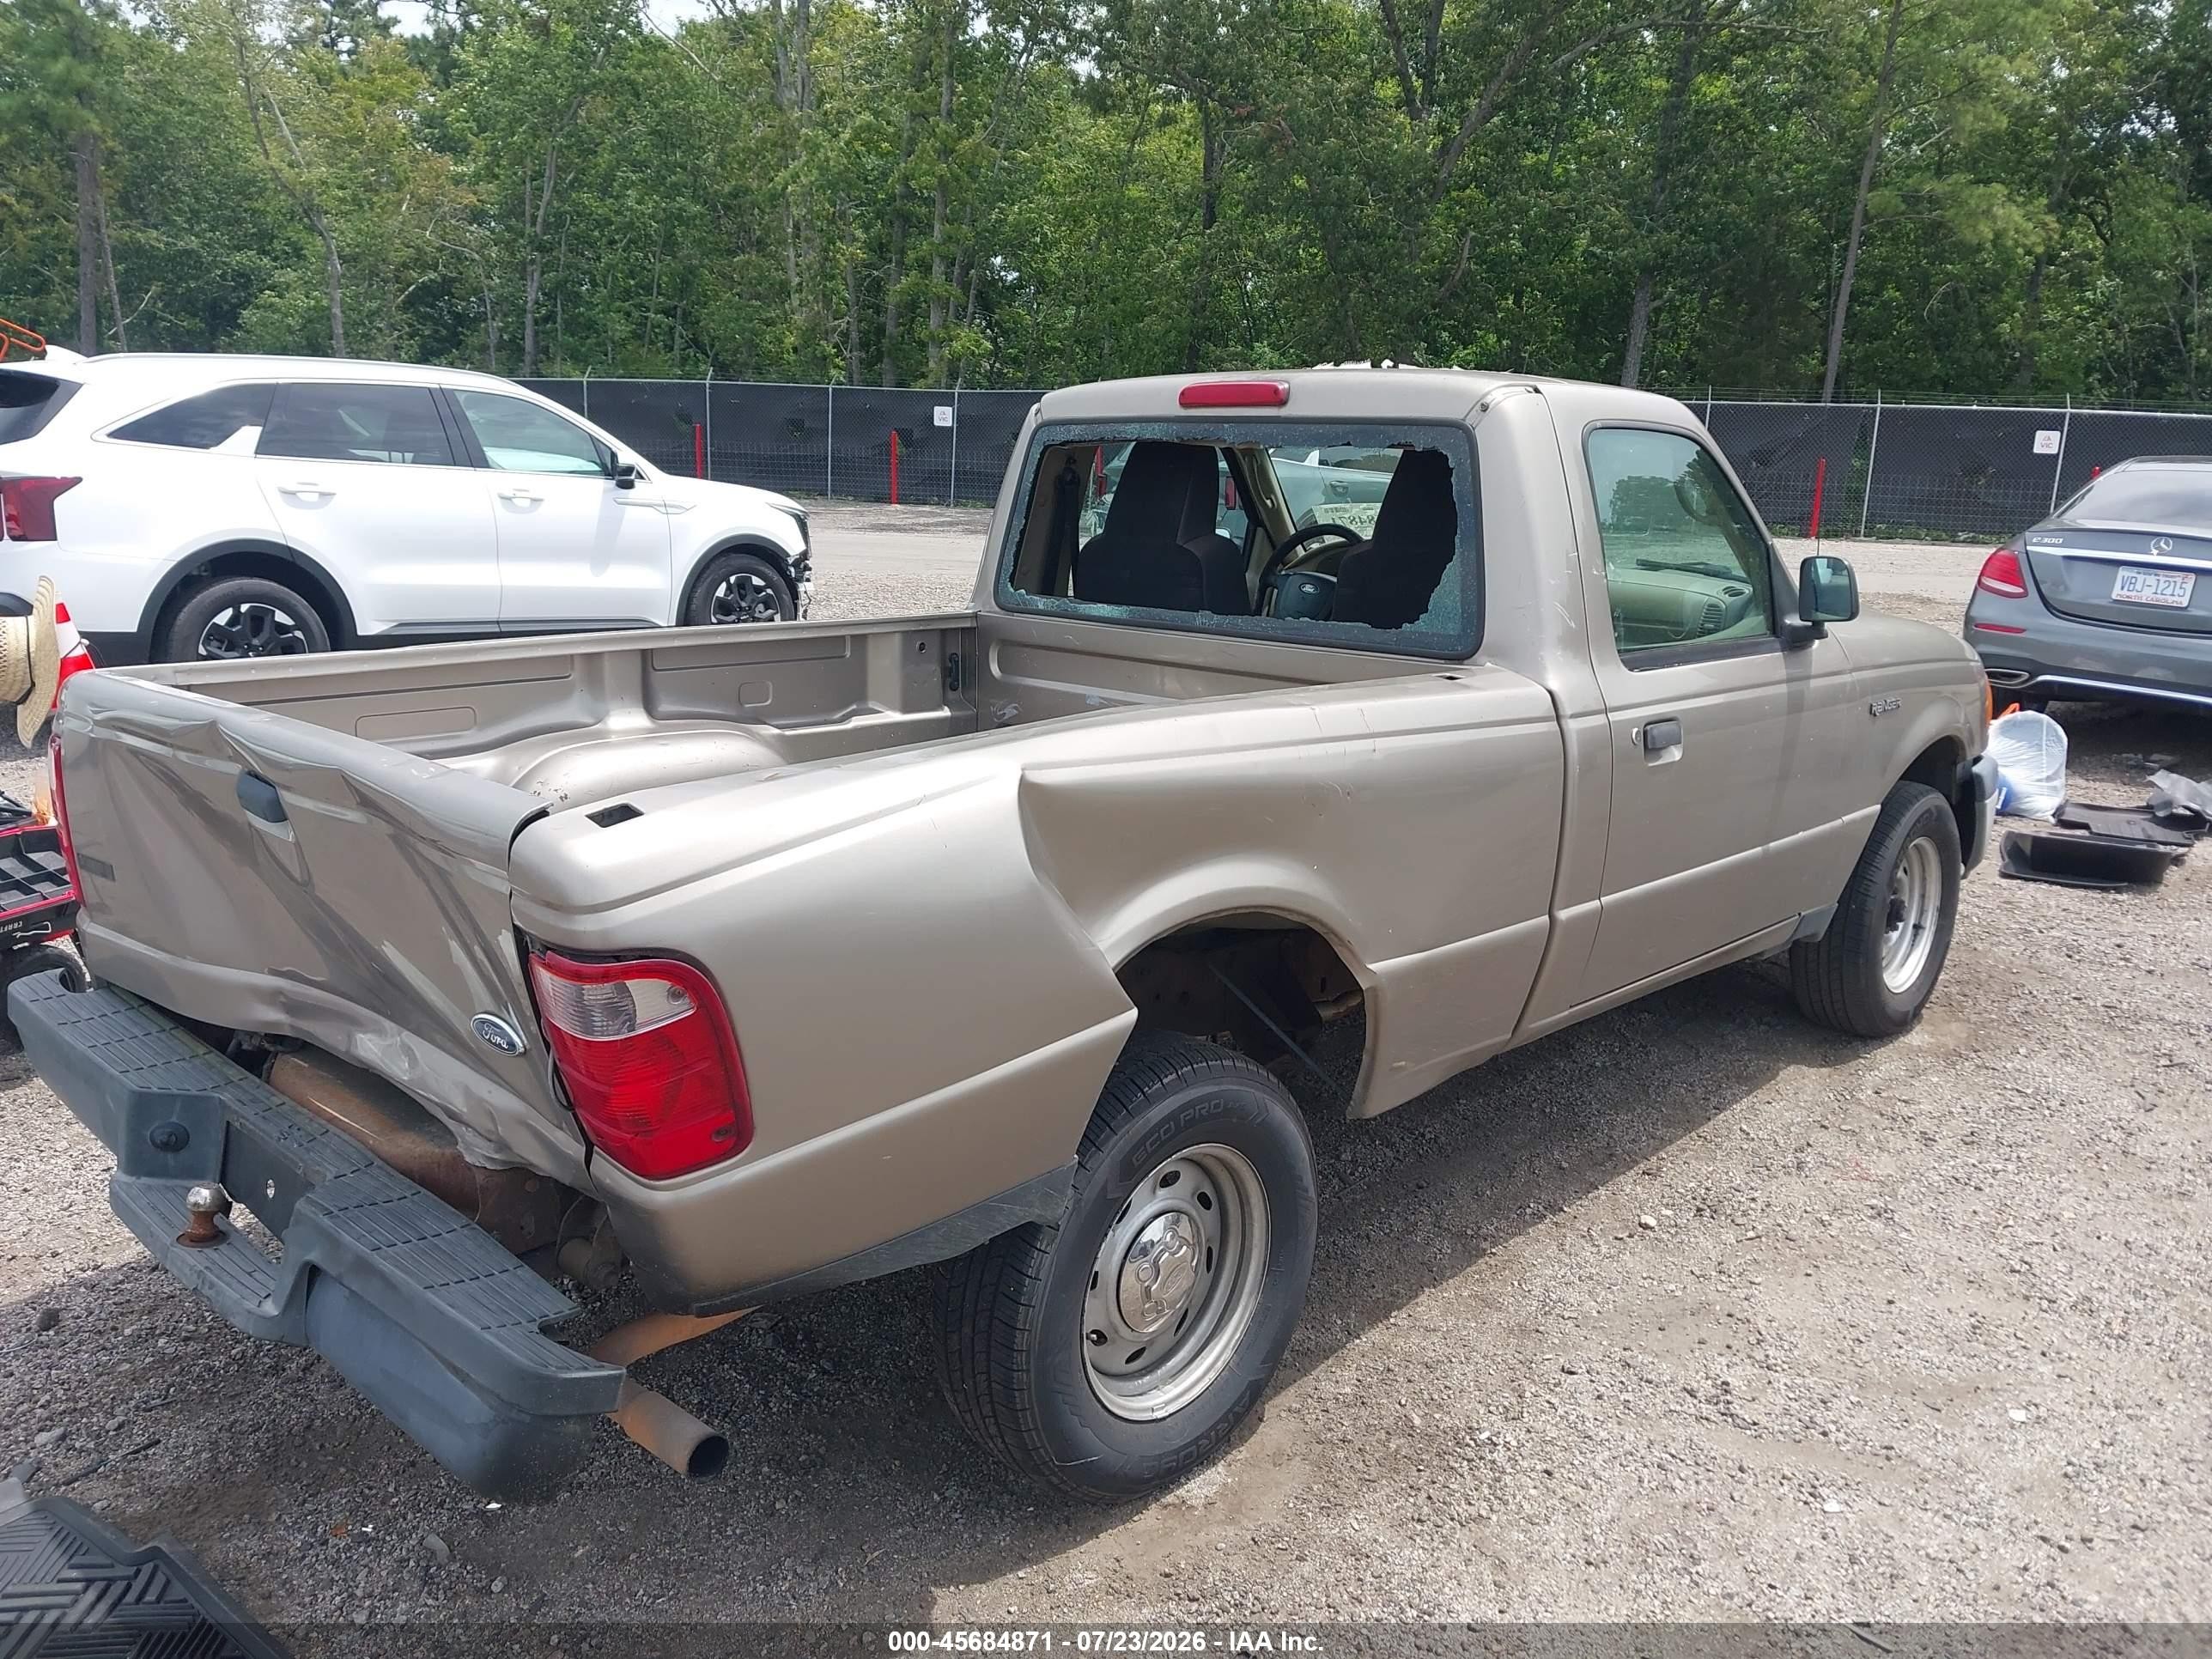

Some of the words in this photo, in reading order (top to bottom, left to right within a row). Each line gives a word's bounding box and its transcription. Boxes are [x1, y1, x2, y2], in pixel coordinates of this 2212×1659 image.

[2119, 574, 2187, 598] VBJ-1215
[1132, 1121, 1176, 1169] ECO
[1179, 1098, 1224, 1127] PRO
